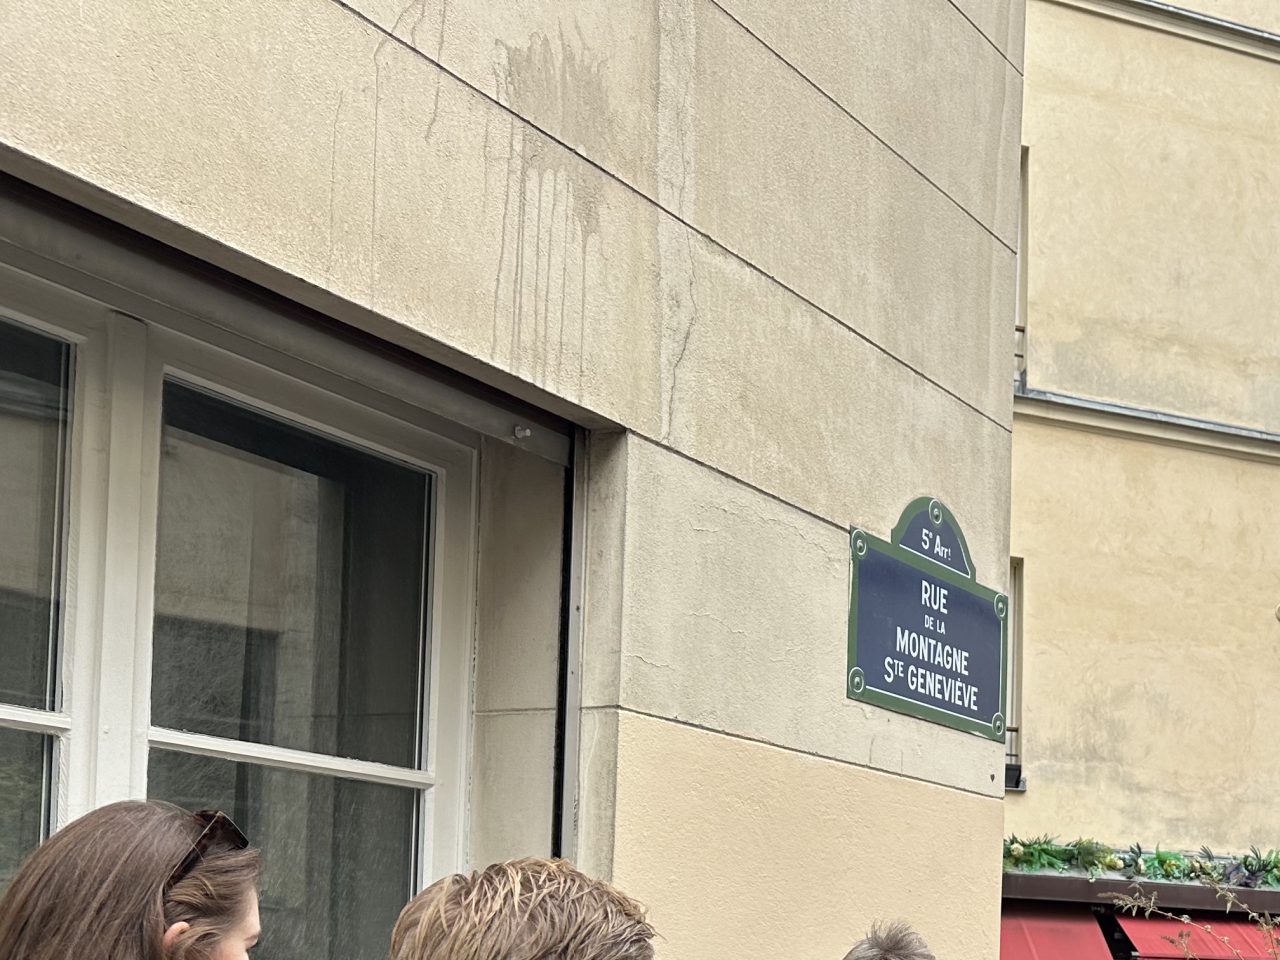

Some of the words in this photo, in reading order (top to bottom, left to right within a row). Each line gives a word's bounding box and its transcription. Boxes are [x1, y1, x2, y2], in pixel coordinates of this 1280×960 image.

[922, 580, 948, 614] RUE
[924, 614, 934, 628] DE
[936, 619, 946, 635] LA
[896, 627, 969, 676] MONTAGNE
[908, 665, 978, 711] GENEVIÈVE
